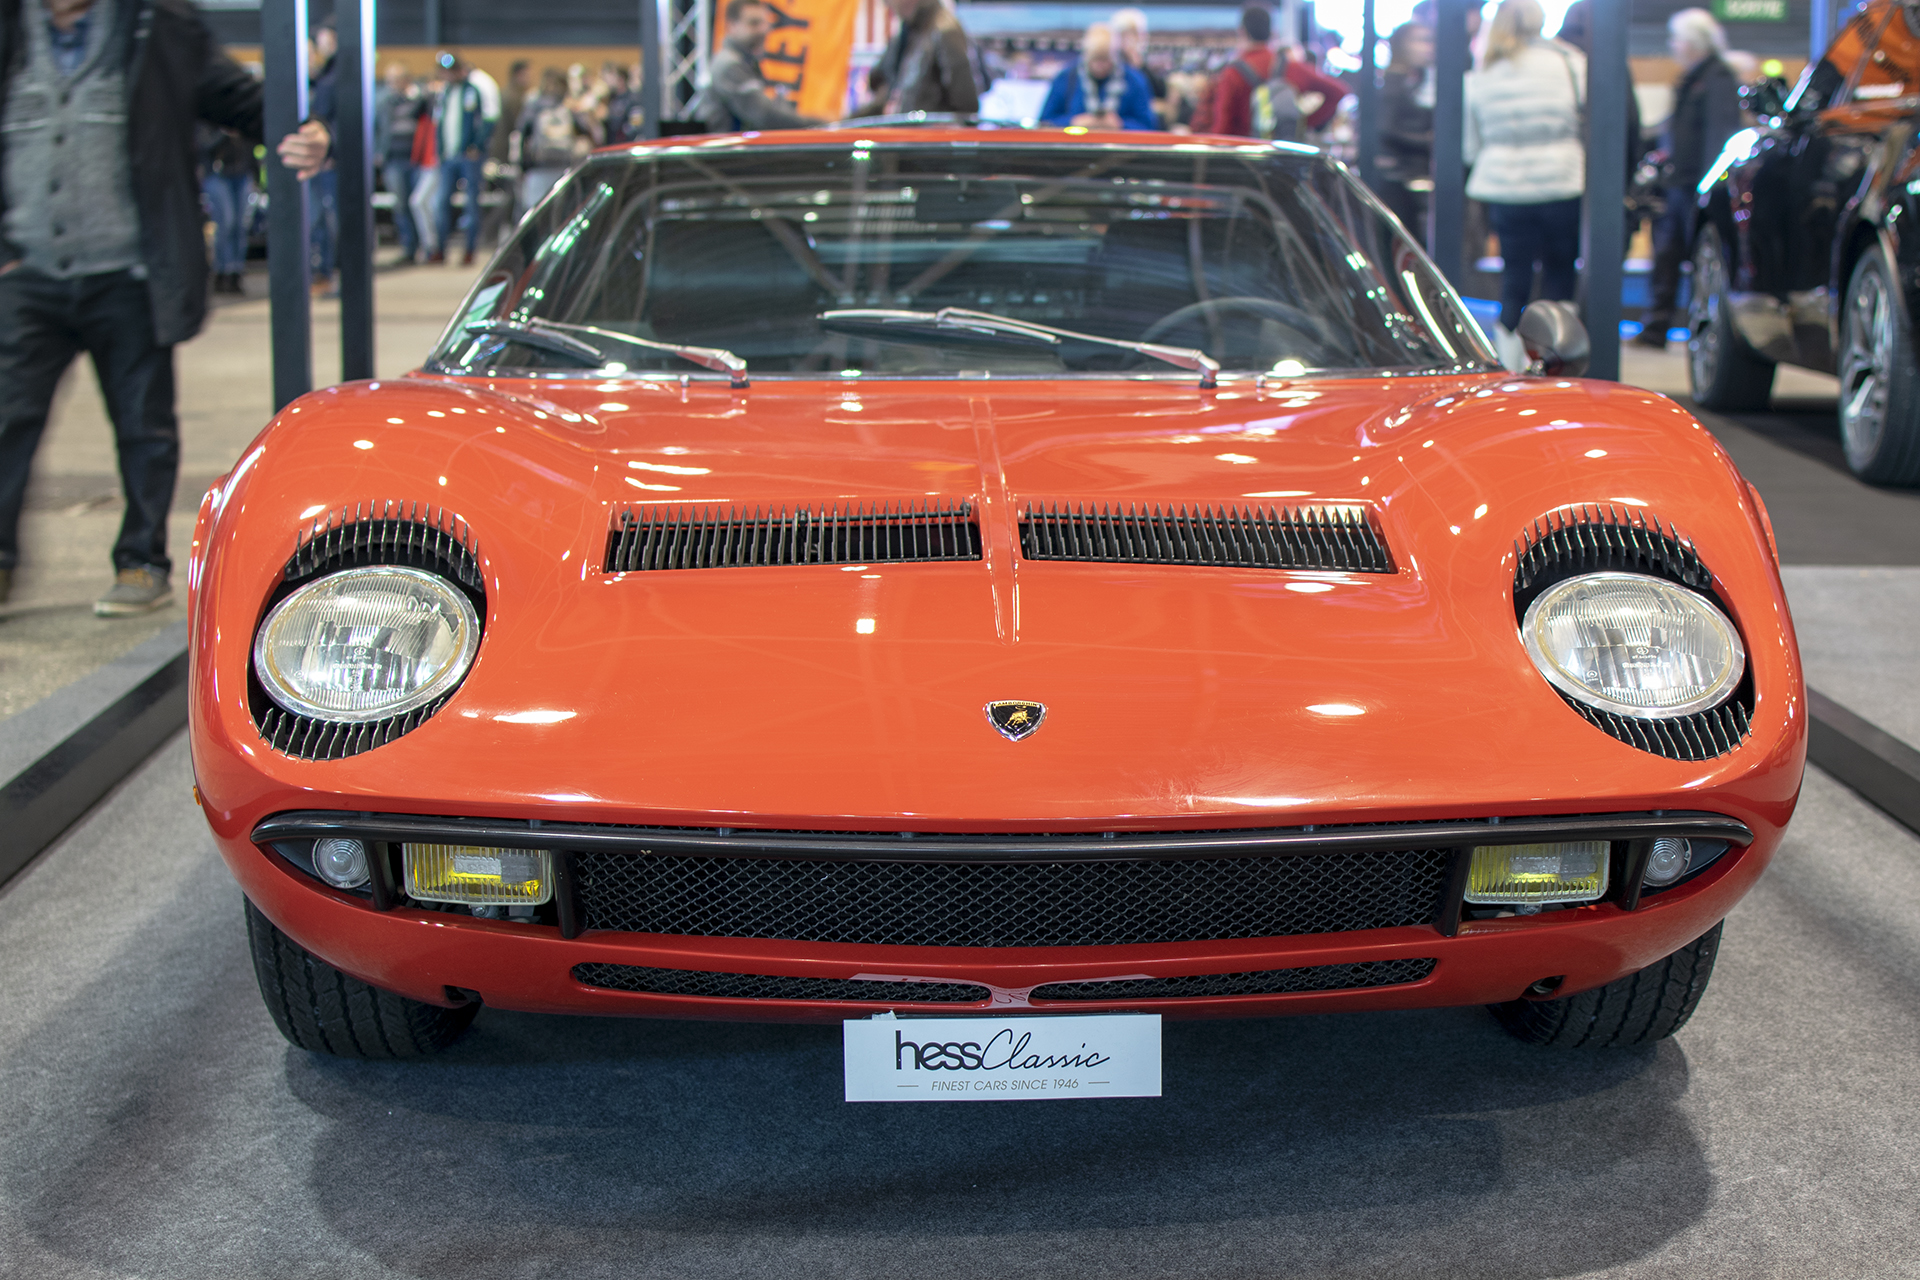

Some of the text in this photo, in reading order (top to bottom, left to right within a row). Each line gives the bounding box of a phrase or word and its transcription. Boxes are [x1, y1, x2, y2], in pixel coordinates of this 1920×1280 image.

[931, 1078, 1079, 1091] FINEST CARS SINCE 1946
